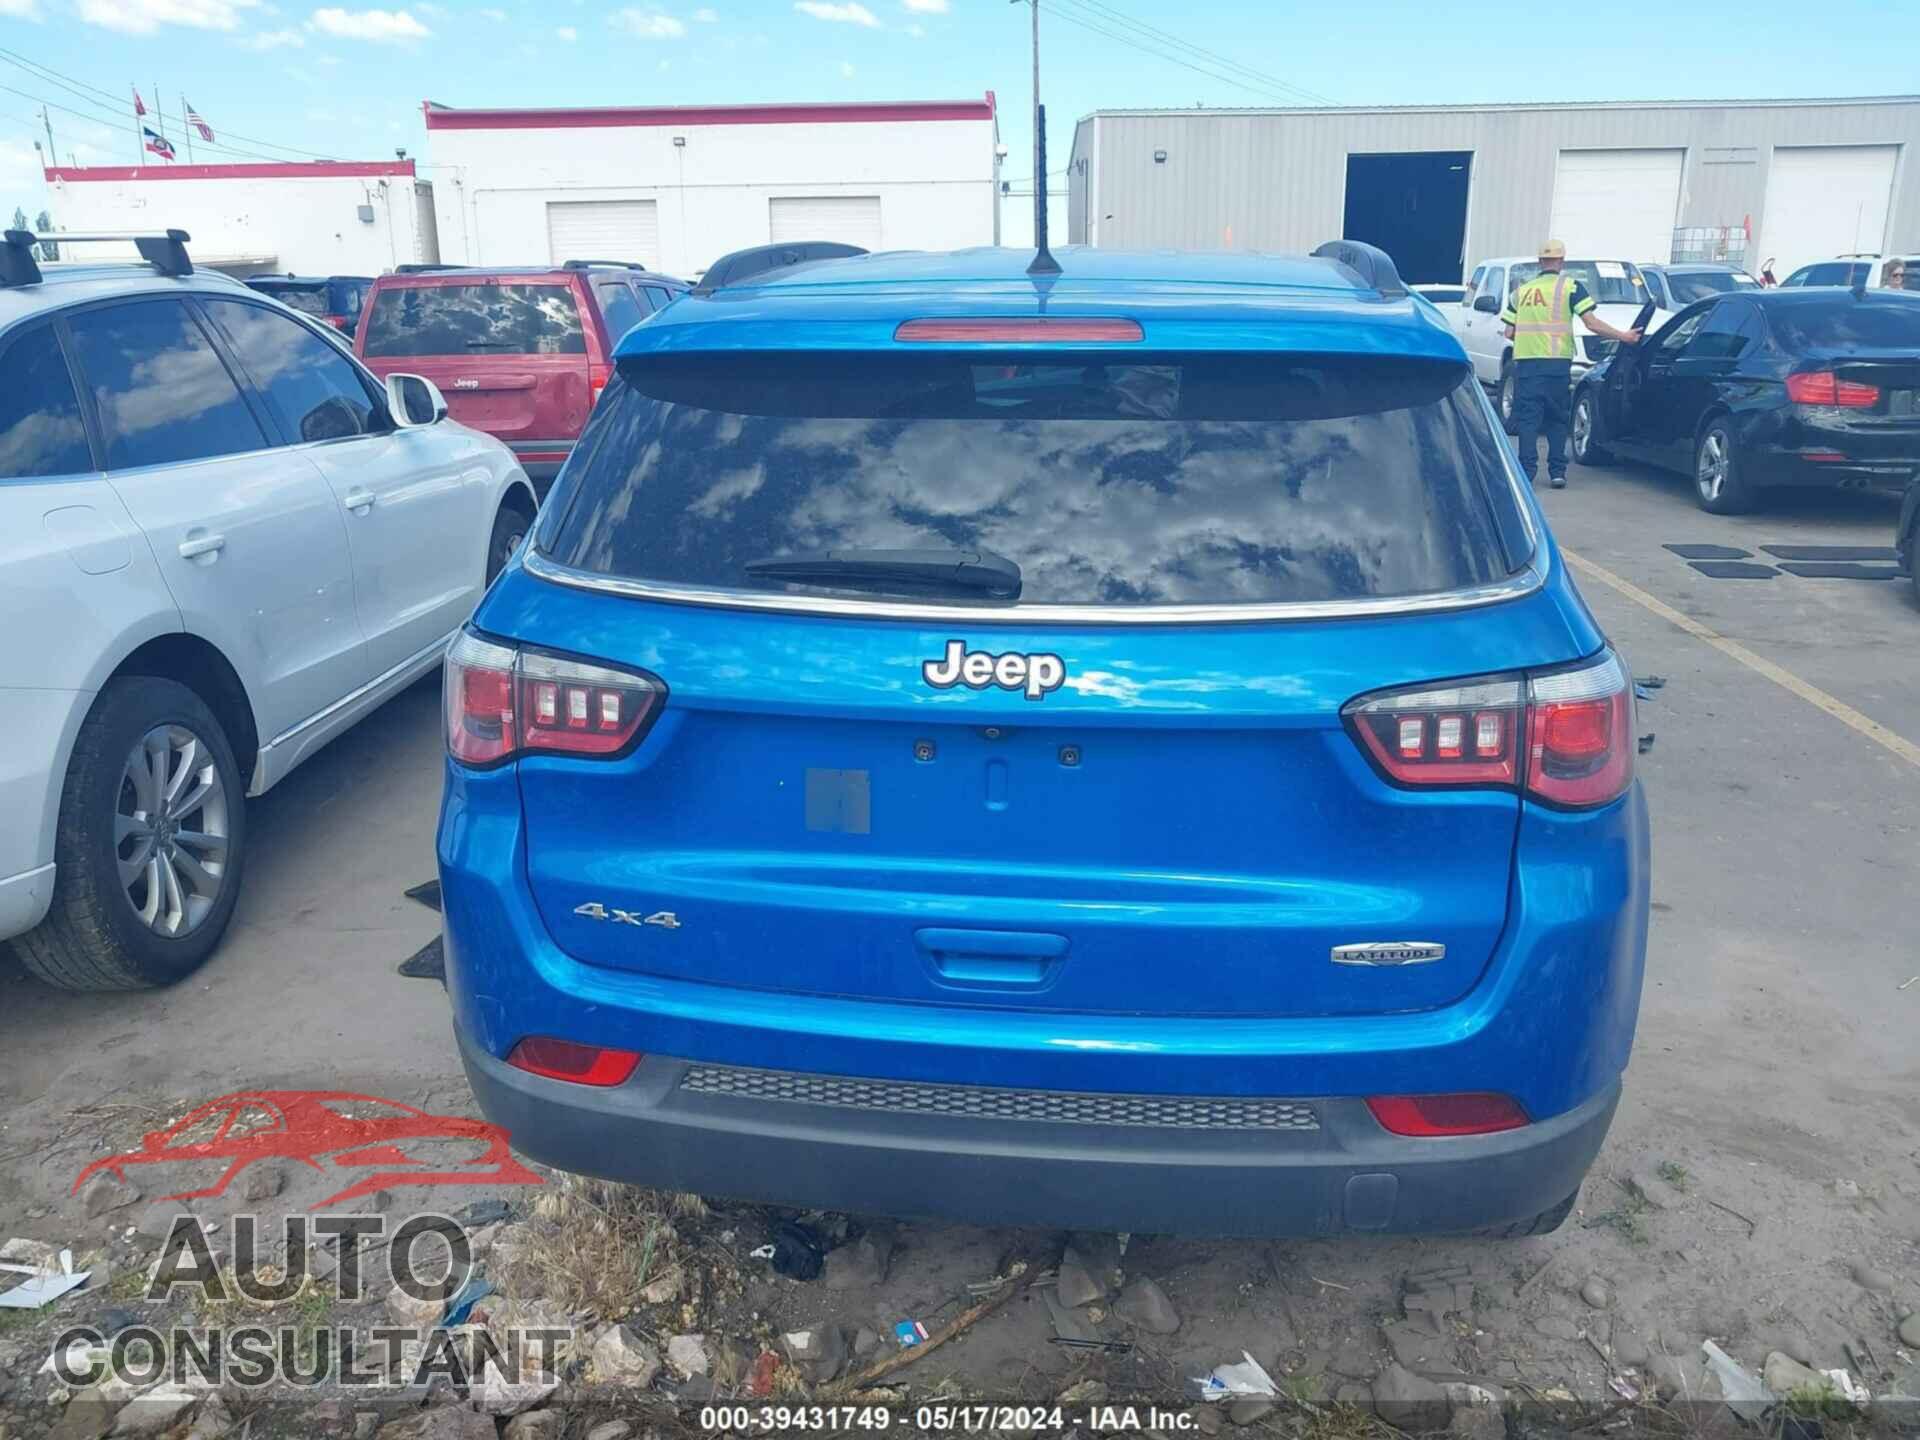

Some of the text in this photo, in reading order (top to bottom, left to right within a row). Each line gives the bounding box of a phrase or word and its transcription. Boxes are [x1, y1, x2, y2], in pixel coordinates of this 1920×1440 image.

[454, 378, 479, 389] Jeep
[924, 640, 1065, 699] Jeep
[1342, 949, 1435, 961] LATITUDE
